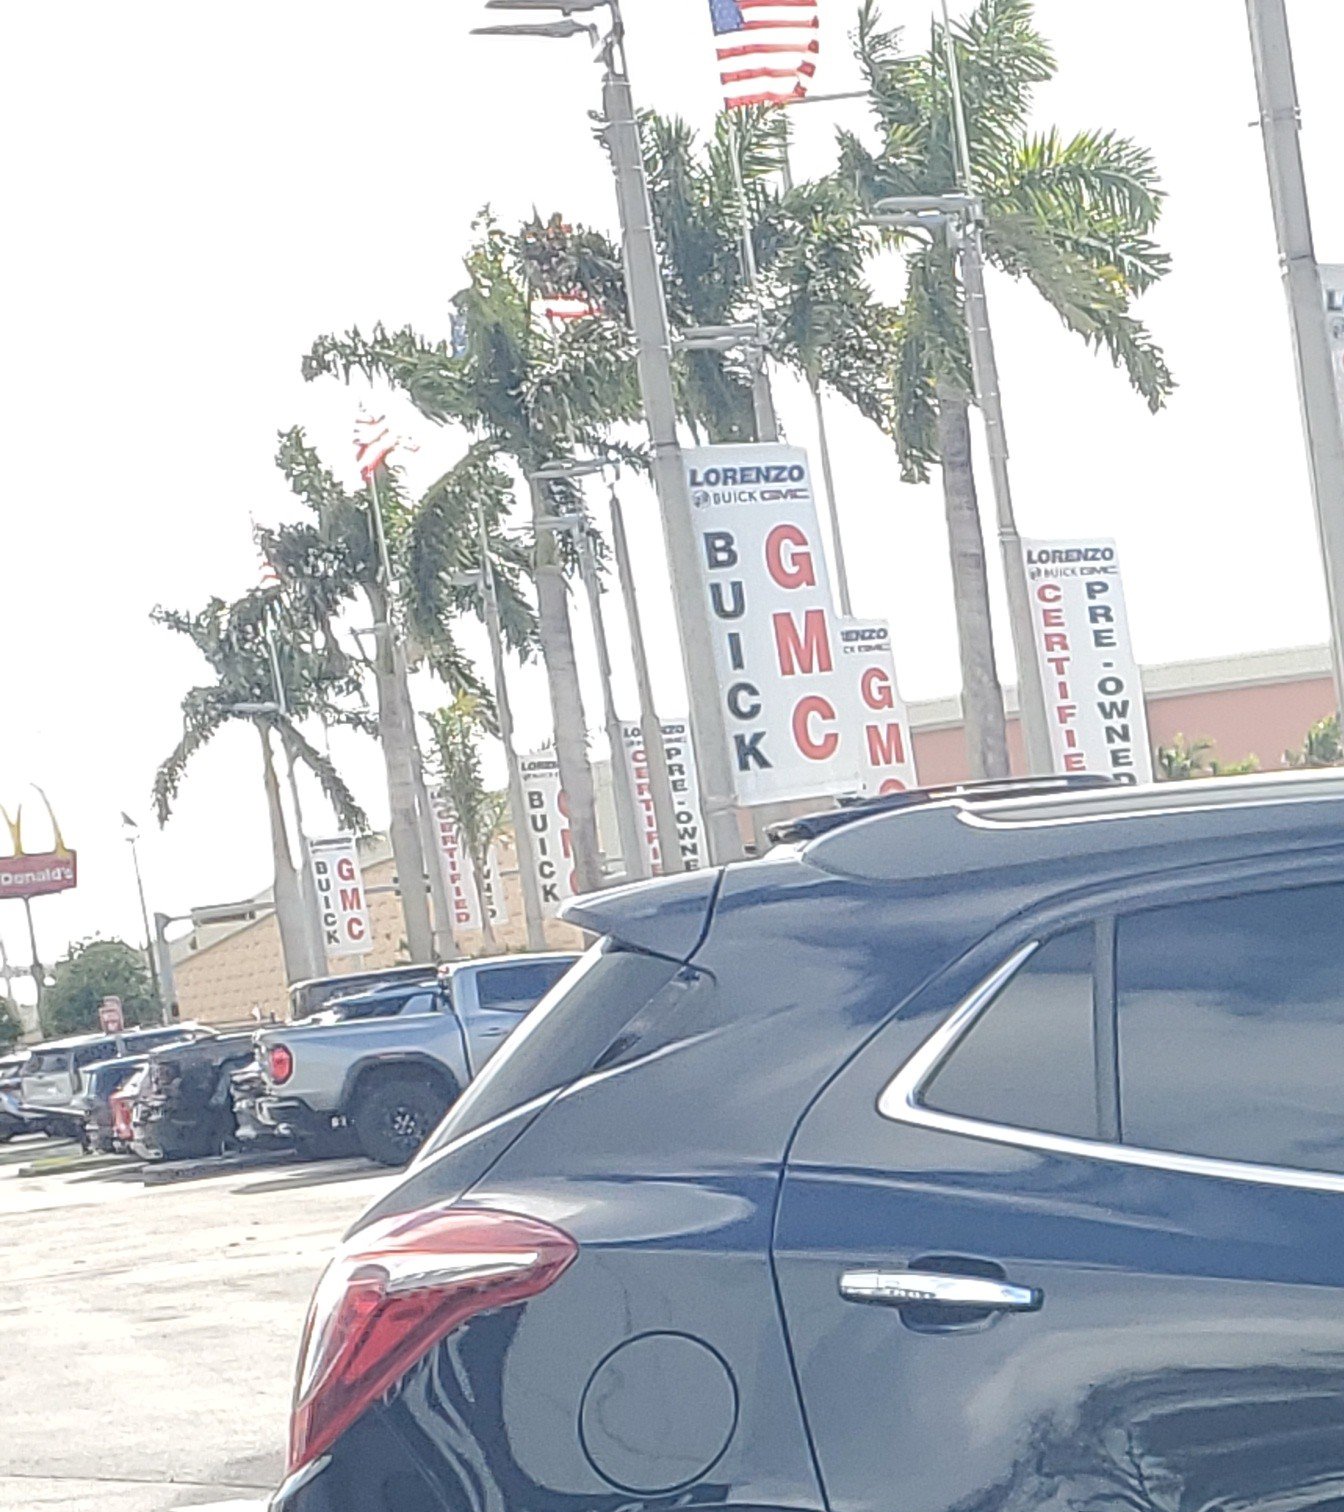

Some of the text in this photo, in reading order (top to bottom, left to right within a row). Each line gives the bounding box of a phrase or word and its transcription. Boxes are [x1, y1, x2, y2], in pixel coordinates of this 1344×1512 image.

[689, 465, 805, 487] LORENZO
[713, 491, 757, 505] BUICK
[1027, 548, 1114, 565] LORENZO
[703, 531, 773, 771] BUICK
[764, 524, 839, 761] GMC
[841, 628, 888, 642] ENZO
[1037, 584, 1086, 772] CERTIFIE
[528, 791, 560, 902] BUICK
[632, 750, 661, 877] CERTIFIE
[665, 748, 699, 871] PRE-OWNE
[315, 861, 340, 945] BUICK
[337, 858, 365, 940] GMC
